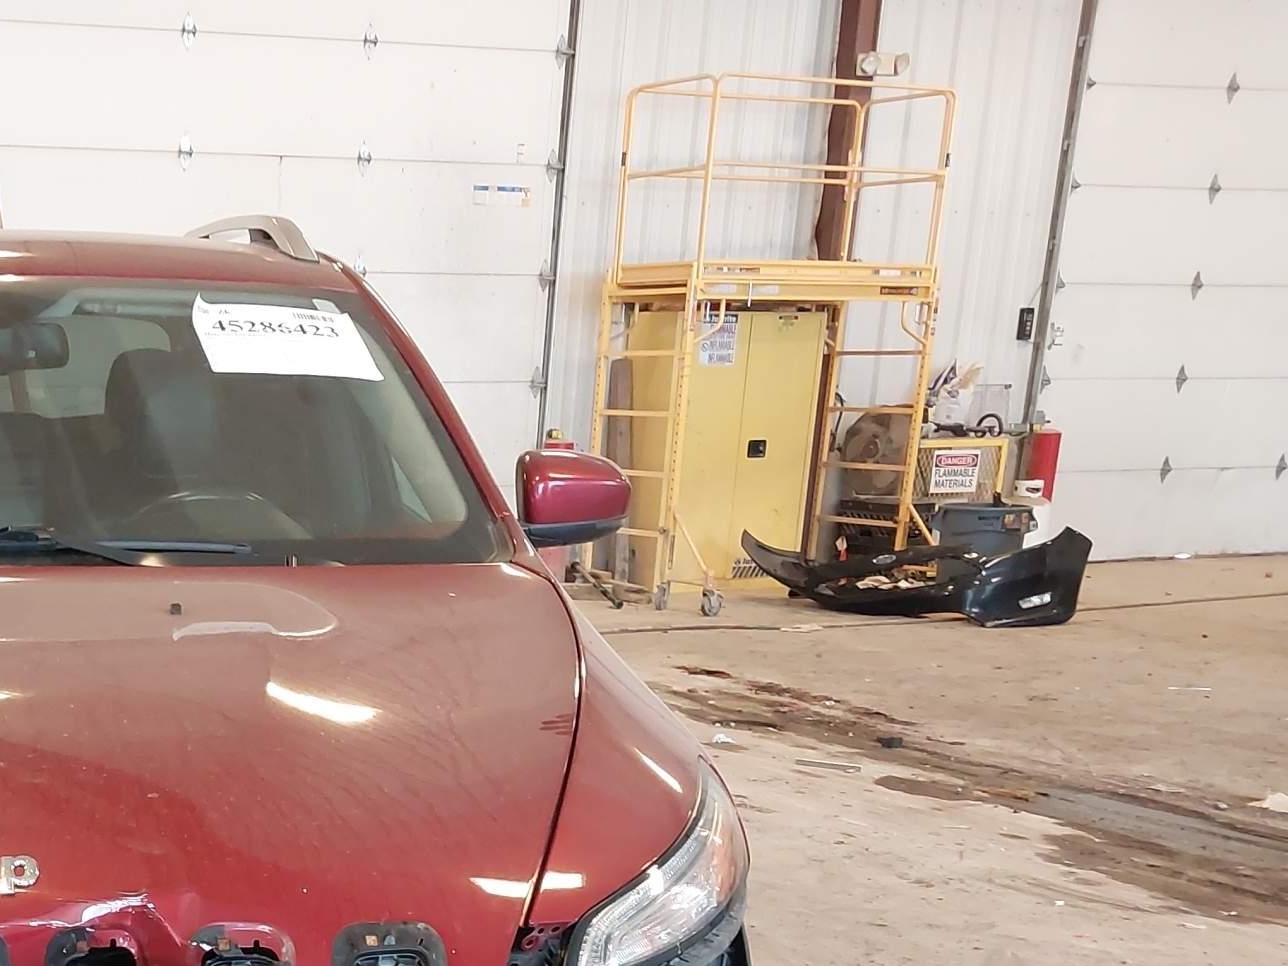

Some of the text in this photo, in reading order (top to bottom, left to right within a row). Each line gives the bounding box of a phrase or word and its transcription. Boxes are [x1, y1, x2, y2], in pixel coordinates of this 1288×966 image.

[212, 319, 340, 338] 45286423
[941, 455, 973, 466] DANGER
[934, 468, 976, 478] FLAMMABLE
[934, 478, 973, 489] MATERIALS
